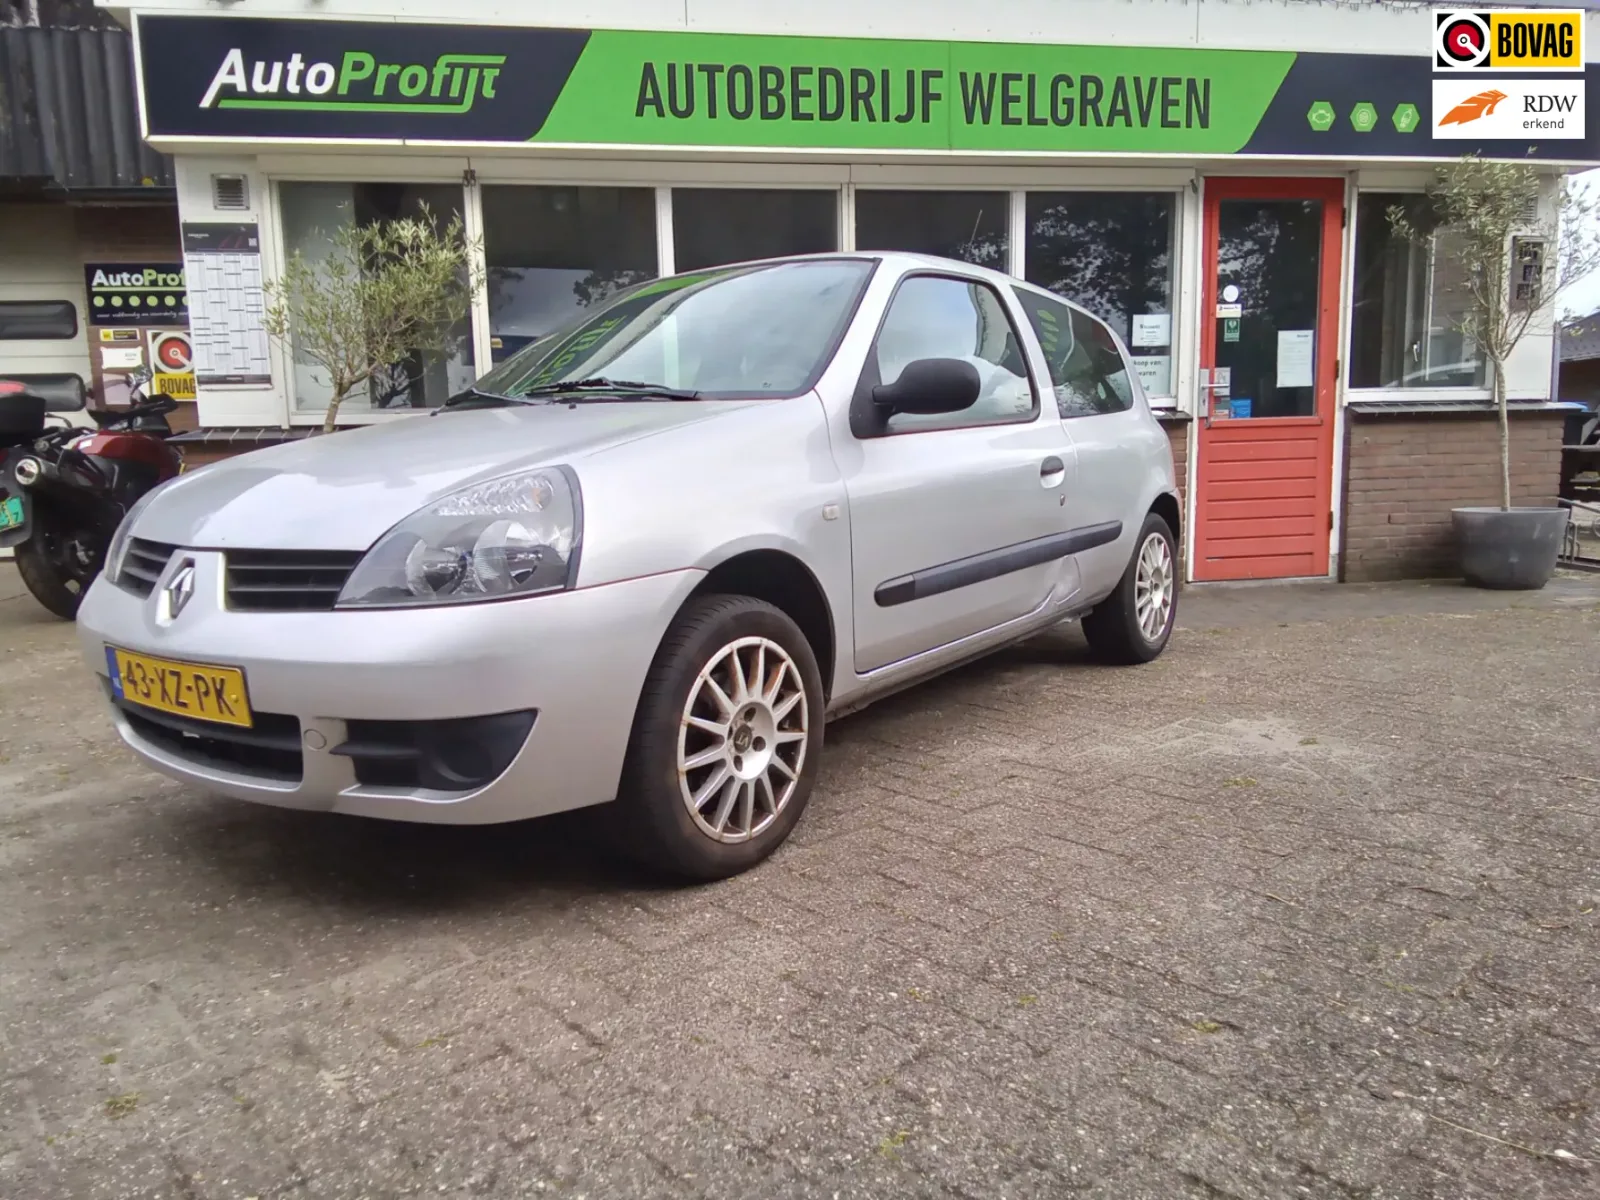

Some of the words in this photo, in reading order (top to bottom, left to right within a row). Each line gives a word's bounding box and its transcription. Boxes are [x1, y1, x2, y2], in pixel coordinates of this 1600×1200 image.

[199, 48, 506, 113] AutoProfijt
[635, 62, 943, 123] AUTOBEDRIJF
[959, 71, 1210, 129] WELGRAVEN
[160, 377, 197, 395] BOVAG
[126, 660, 235, 716] 43-XZ-PK
